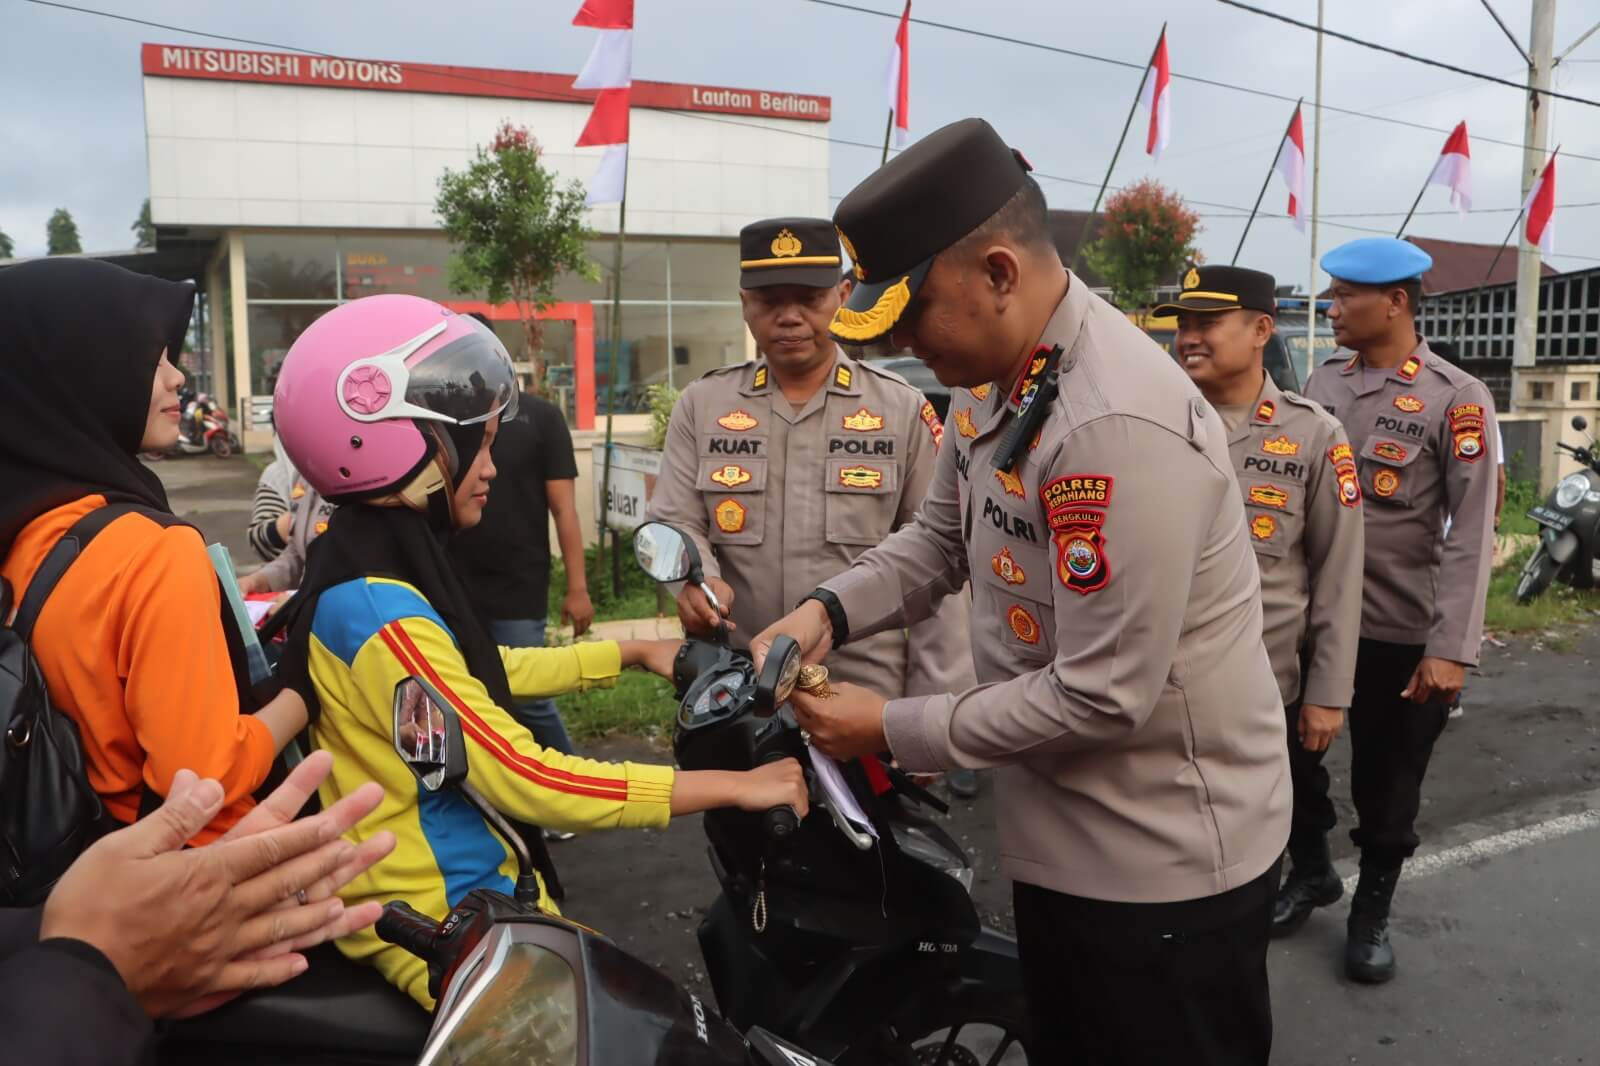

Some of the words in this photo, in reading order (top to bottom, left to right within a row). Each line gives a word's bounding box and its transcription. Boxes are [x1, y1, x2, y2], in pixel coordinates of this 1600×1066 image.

[162, 47, 299, 77] MITSUBISHI
[310, 58, 402, 84] MOTORS
[693, 87, 752, 109] Lautan
[760, 93, 819, 114] Berlian
[1375, 416, 1425, 438] POLRI
[709, 438, 762, 455] KUAT
[829, 438, 894, 456] POLRI
[1244, 457, 1304, 479] POLRI
[598, 482, 638, 517] eluar
[1045, 479, 1106, 500] POLRES
[1049, 490, 1105, 510] KEPAHIANG
[984, 496, 1037, 542] POLRI
[1053, 513, 1100, 525] BENGKULU
